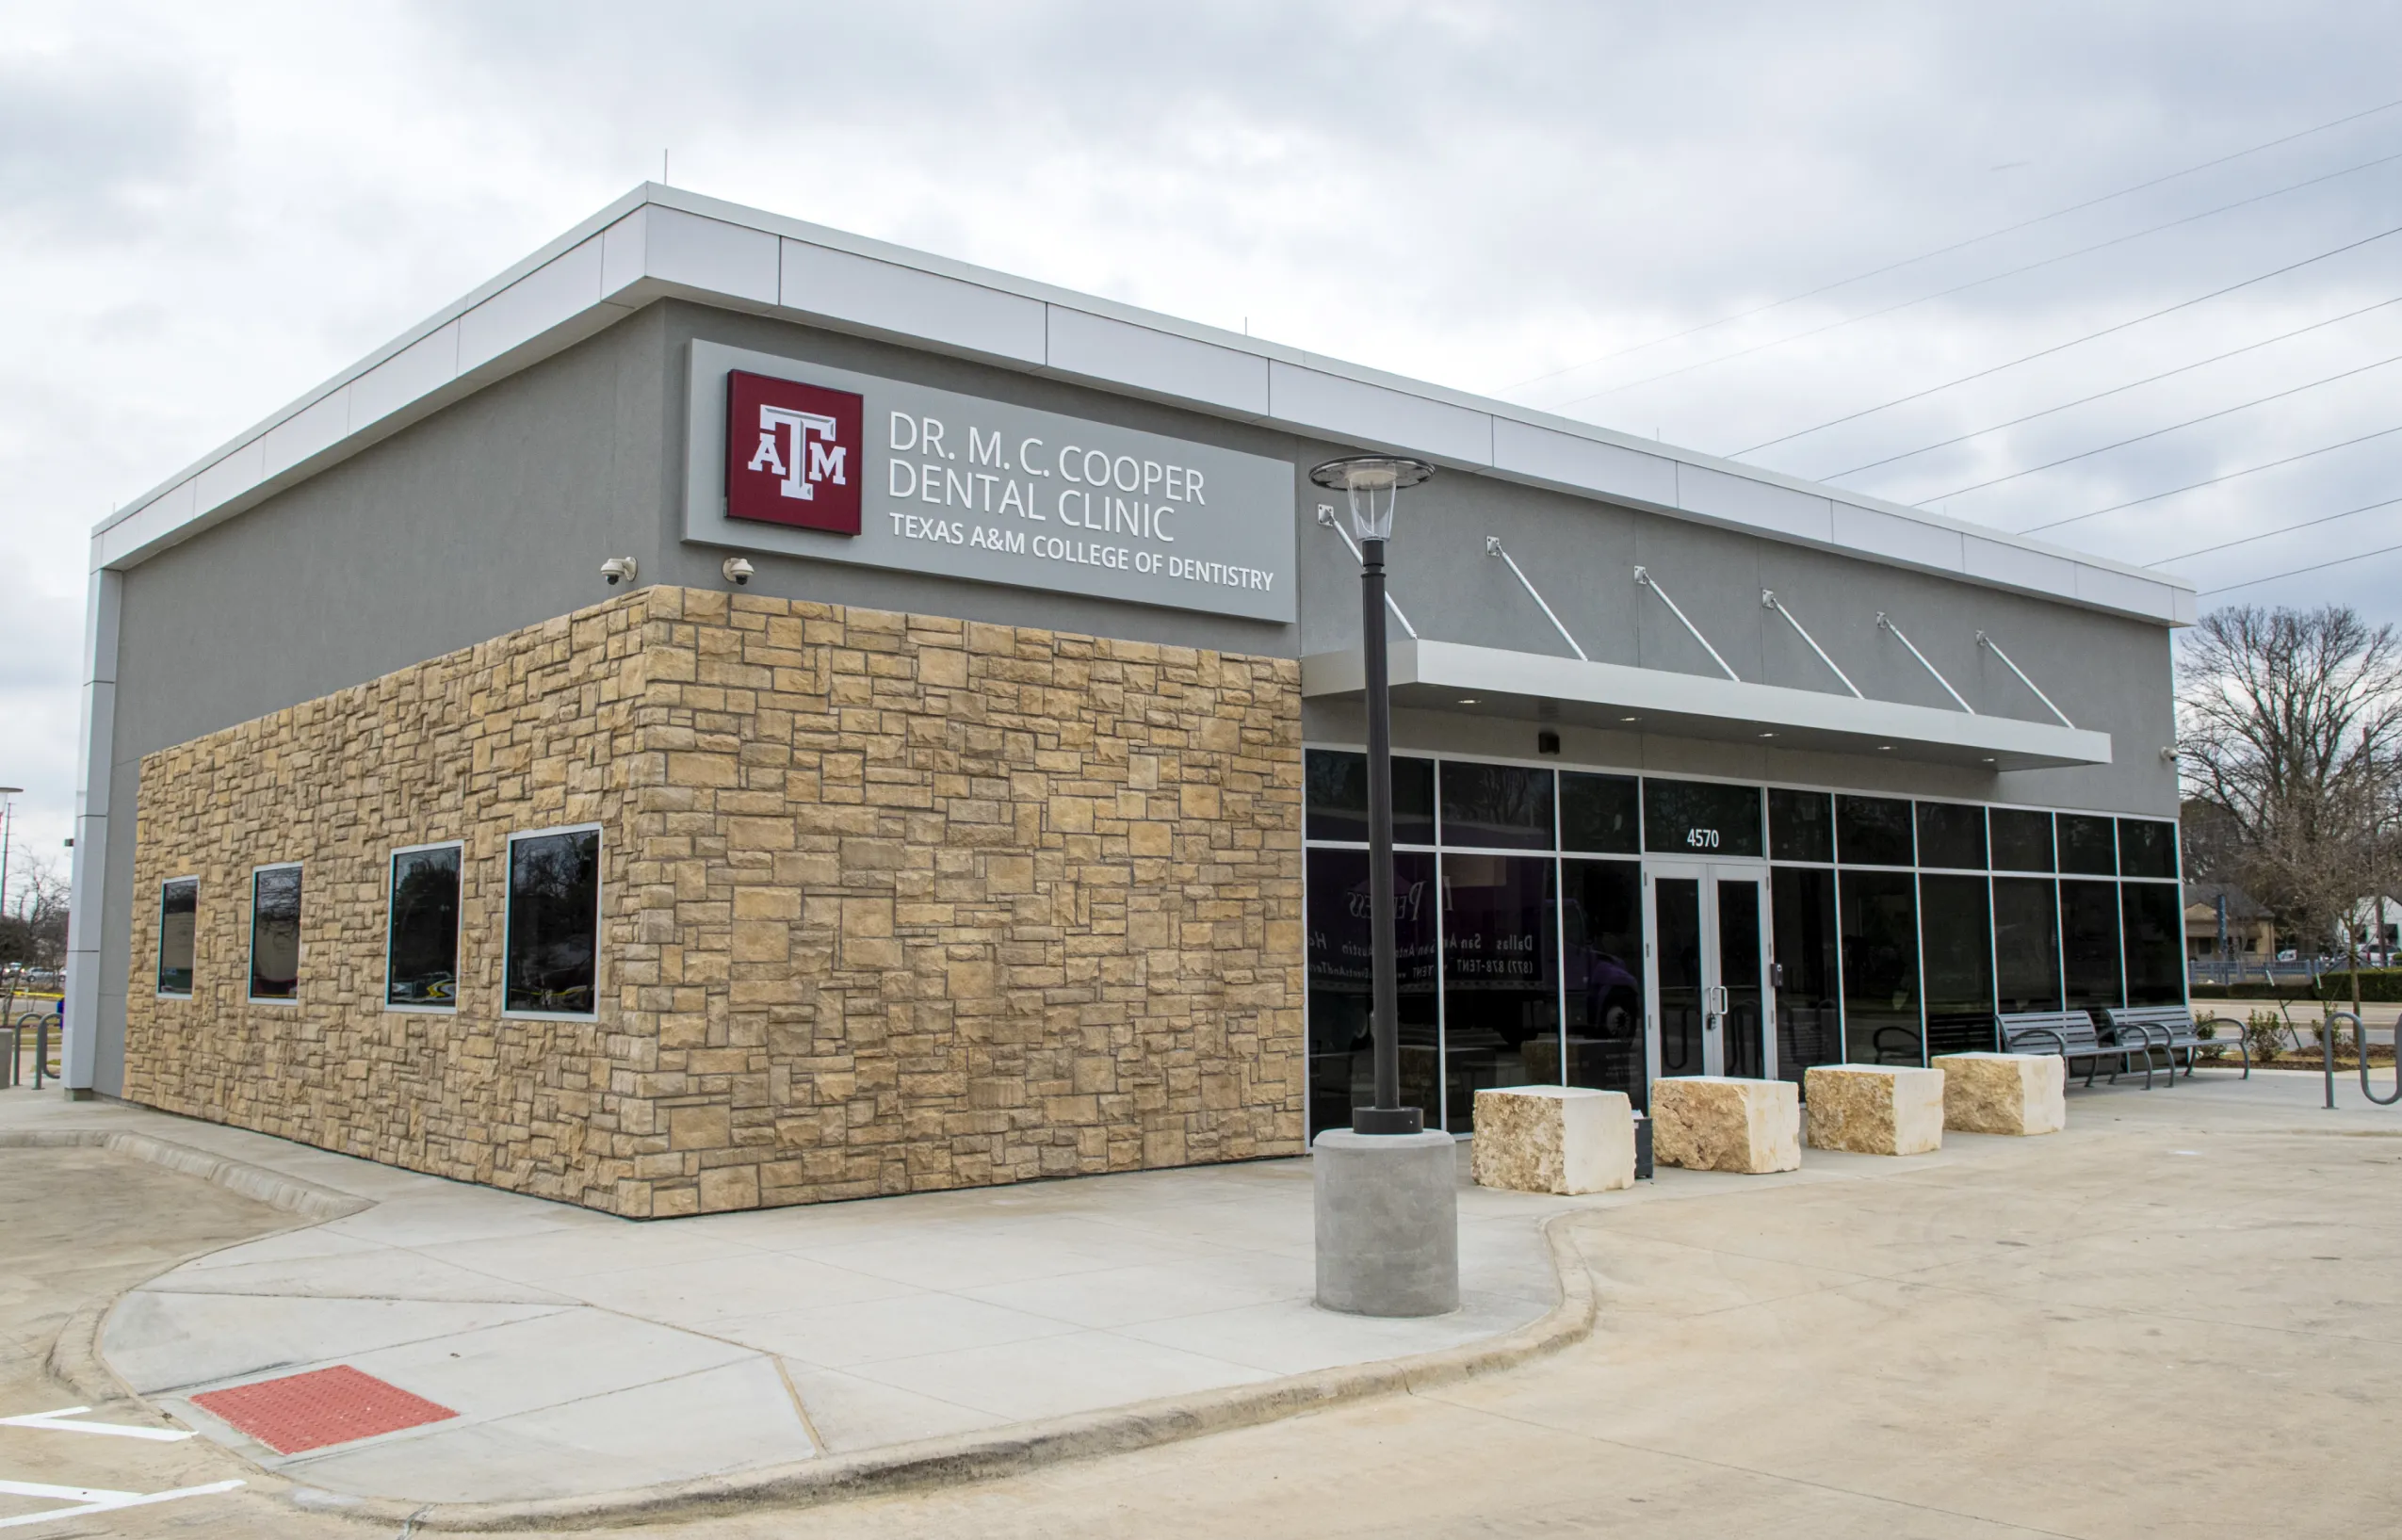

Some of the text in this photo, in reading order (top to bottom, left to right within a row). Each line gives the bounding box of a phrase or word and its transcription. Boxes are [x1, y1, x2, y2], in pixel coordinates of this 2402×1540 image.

[890, 411, 1206, 506] DR. M. C. COOPER
[889, 458, 1175, 542] DENTAL CLINIC
[889, 511, 1274, 592] TEXAS A&M COLLEGE OF DENTISTRY
[1686, 828, 1719, 848] 4570
